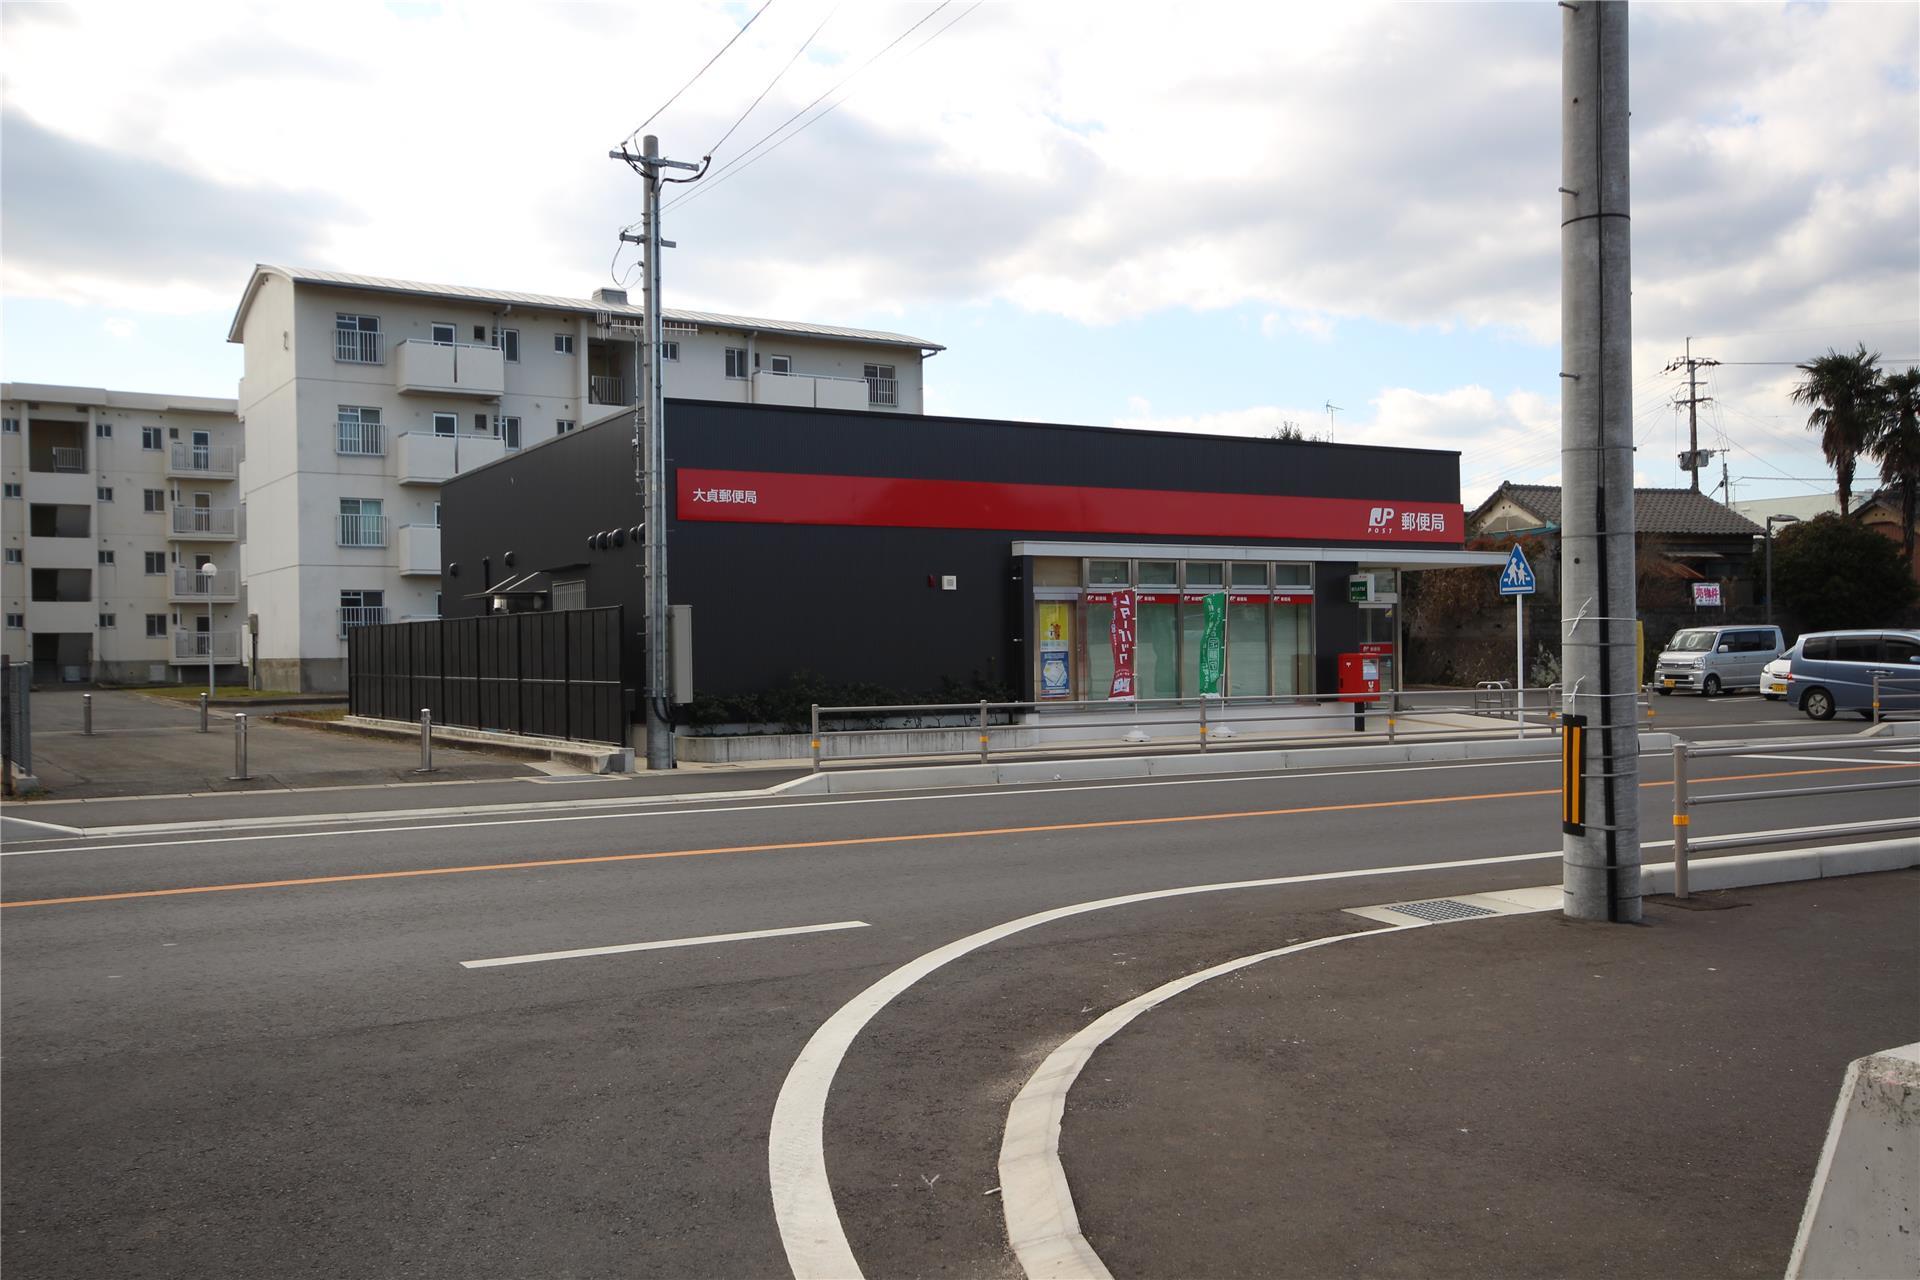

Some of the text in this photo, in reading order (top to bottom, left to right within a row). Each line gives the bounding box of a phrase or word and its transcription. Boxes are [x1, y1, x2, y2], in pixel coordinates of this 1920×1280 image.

[692, 487, 757, 504] 大貞郵便局
[1401, 512, 1445, 532] 郵便局
